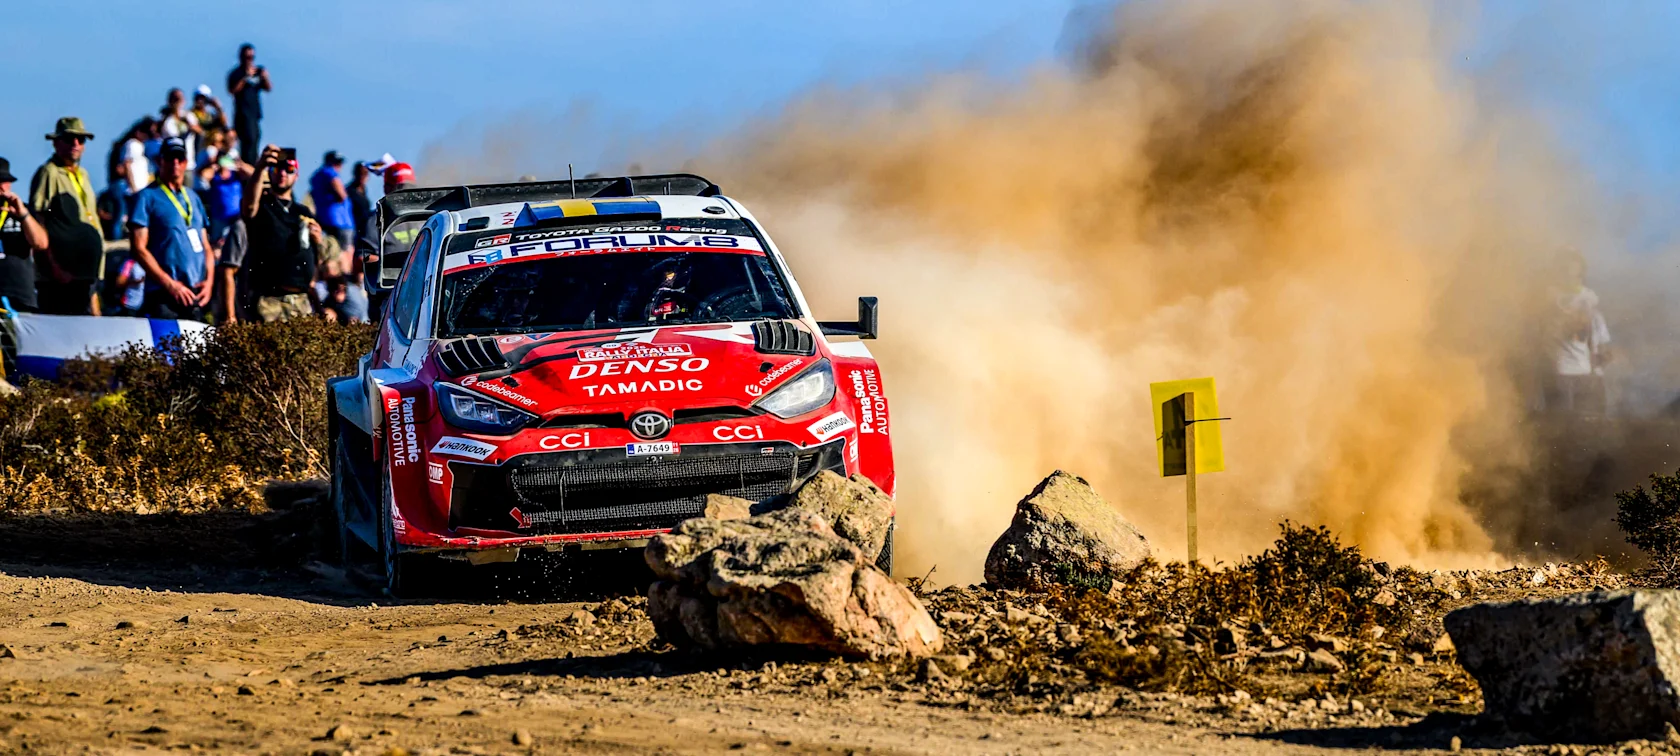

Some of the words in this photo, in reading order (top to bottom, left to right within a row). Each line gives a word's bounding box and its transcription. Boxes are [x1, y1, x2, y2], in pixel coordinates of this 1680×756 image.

[515, 228, 590, 241] TOYOTA
[594, 225, 662, 234] GAZOO
[665, 225, 728, 236] Racing
[510, 234, 740, 257] FORUM8
[584, 348, 632, 360] RALLY
[633, 345, 685, 357] ITALIA
[568, 357, 710, 380] DENSO
[758, 357, 803, 387] codebeamer
[476, 380, 538, 406] codebeamer
[582, 379, 704, 397] TAMADIC
[847, 369, 875, 434] Panasonic
[863, 368, 889, 436] AUTOMOTIVE
[387, 398, 406, 467] AUTOMOTIVE
[401, 396, 422, 463] Panasonic
[637, 443, 670, 453] A-7649
